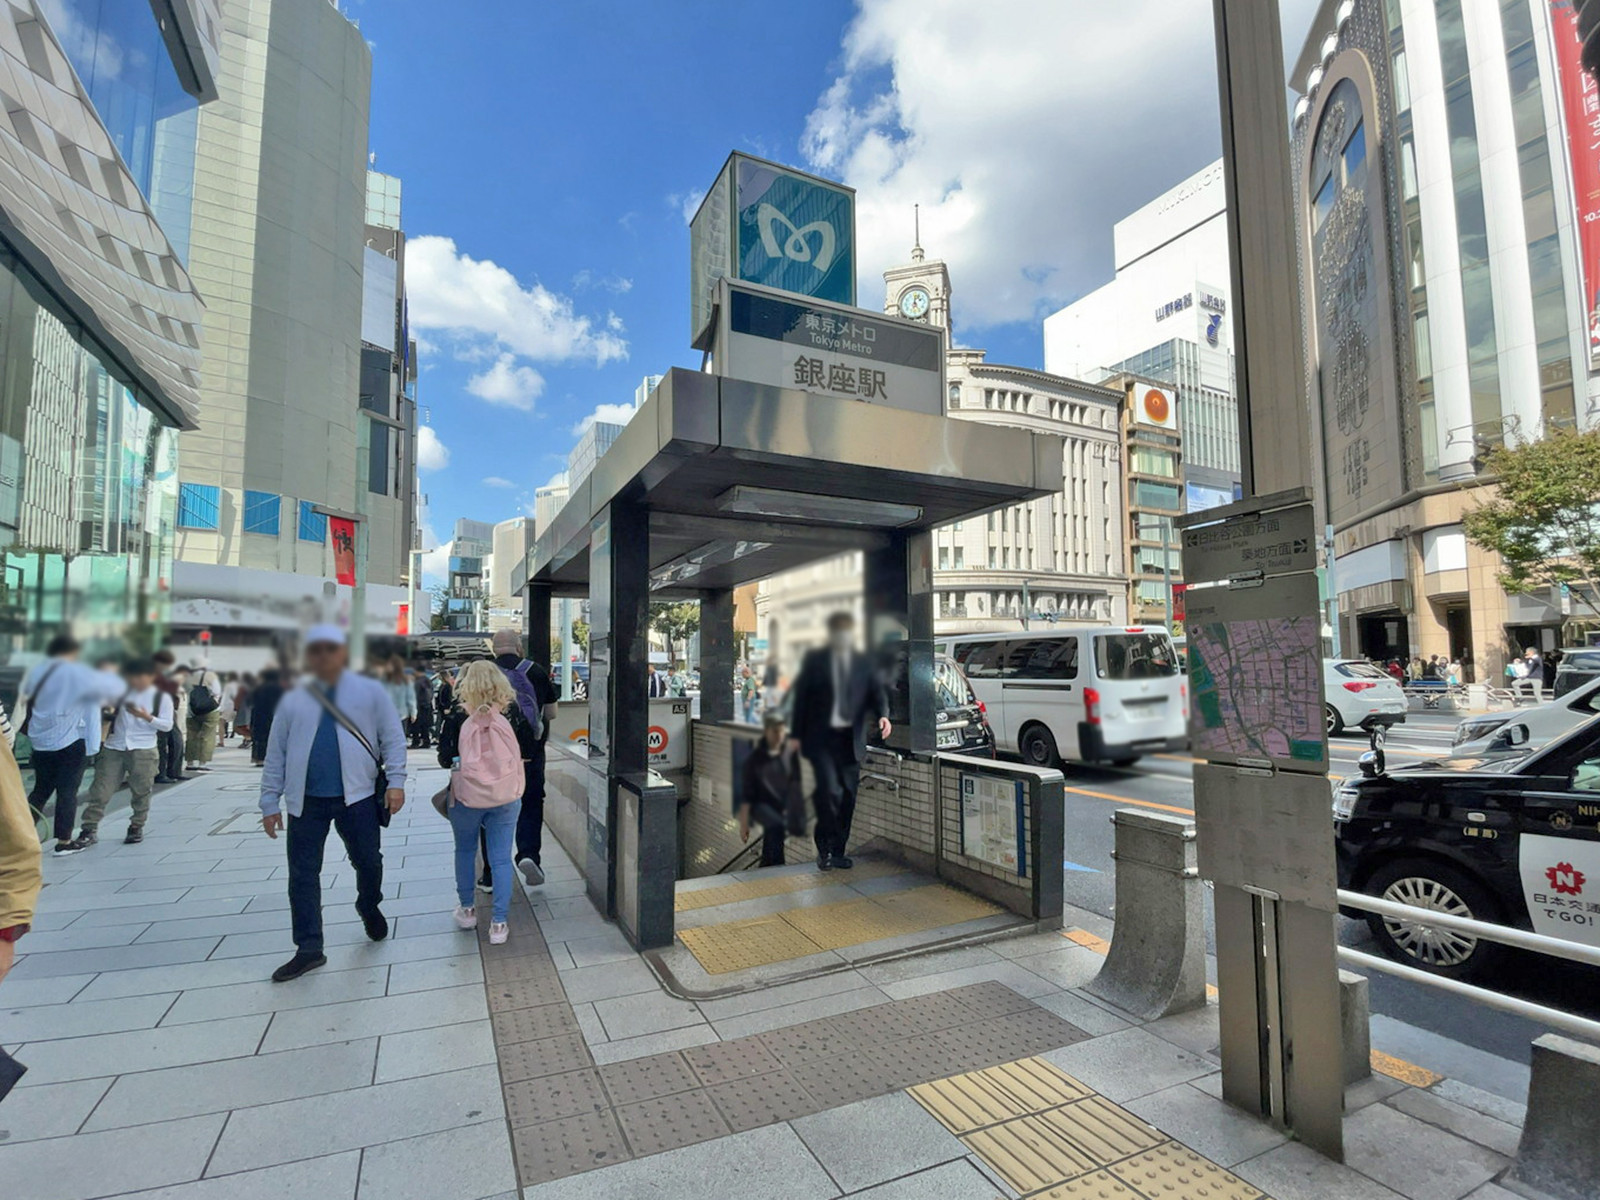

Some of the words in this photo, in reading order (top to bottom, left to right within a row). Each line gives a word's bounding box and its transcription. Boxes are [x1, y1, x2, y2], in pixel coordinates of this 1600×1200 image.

[805, 314, 876, 341] 東京メトロ
[810, 332, 841, 349] Tokyo
[842, 339, 873, 355] Metro
[794, 354, 888, 400] 銀座駅
[673, 705, 686, 714] A5
[649, 734, 661, 745] M
[1543, 908, 1593, 927] でGO!
